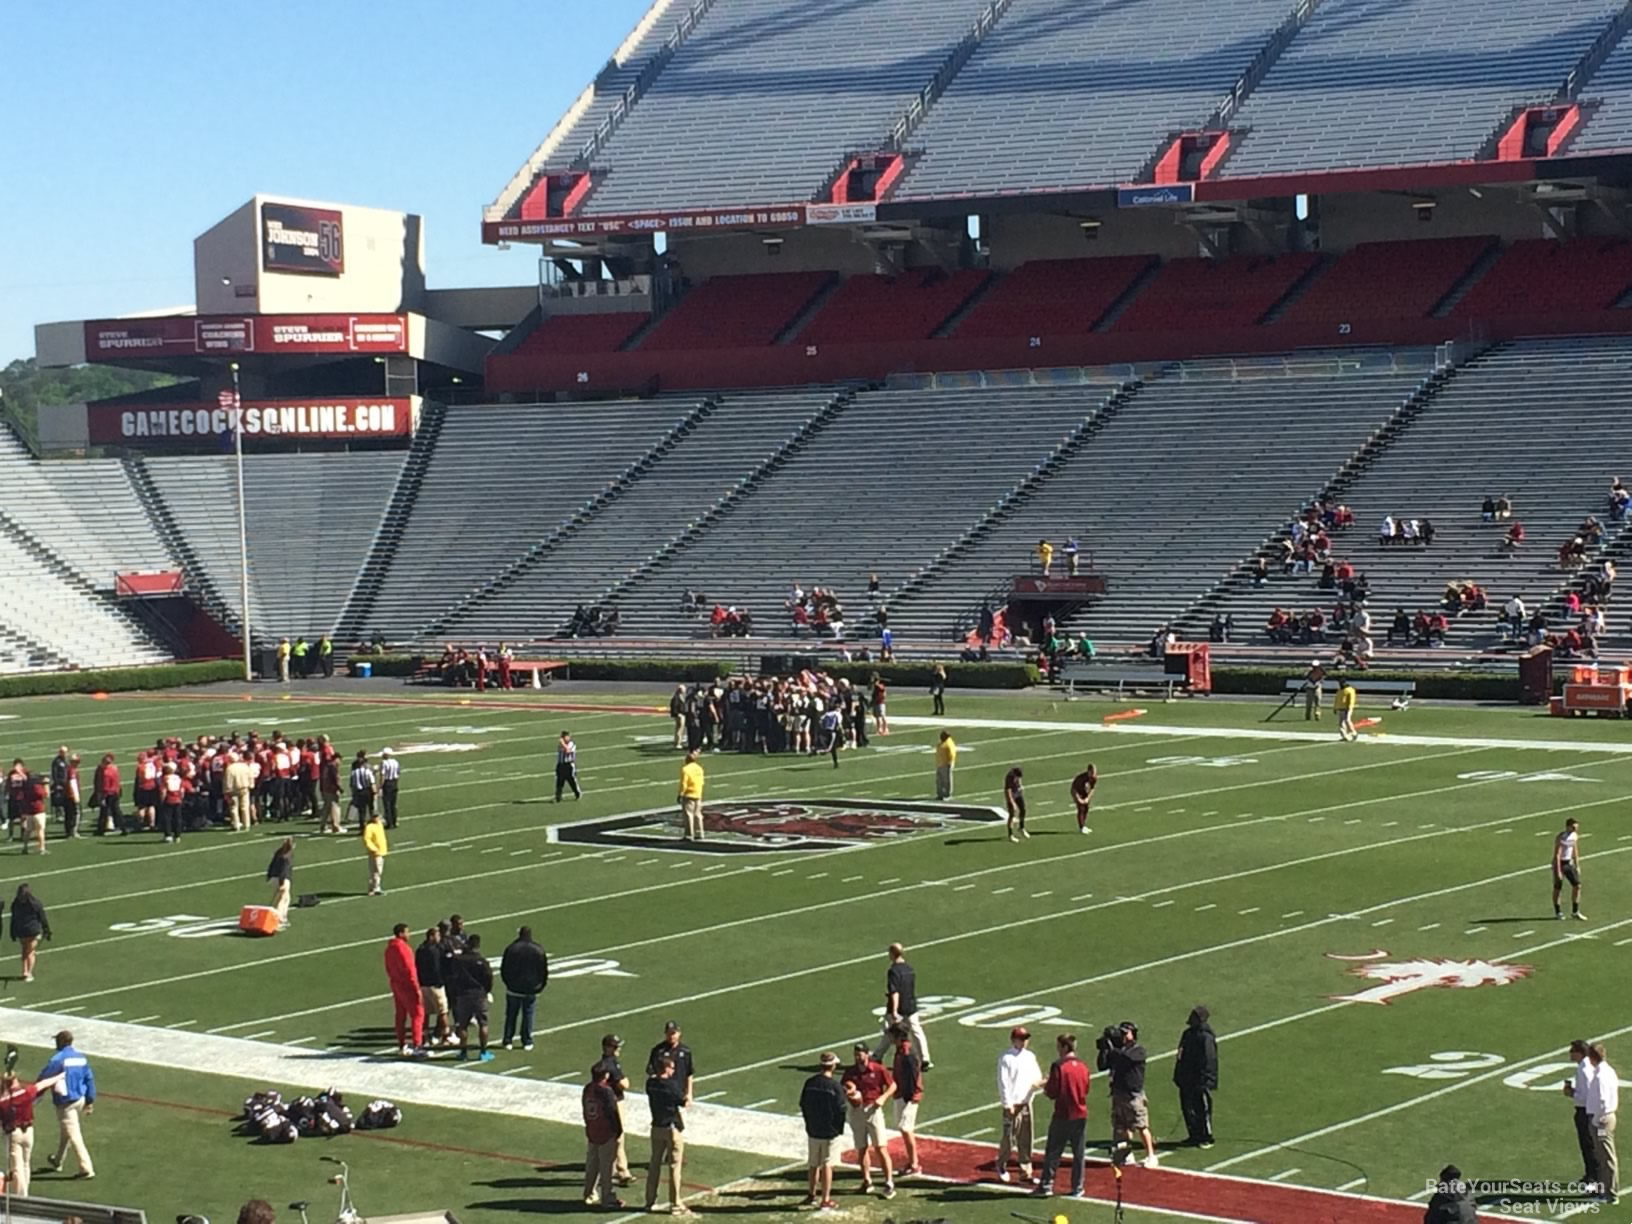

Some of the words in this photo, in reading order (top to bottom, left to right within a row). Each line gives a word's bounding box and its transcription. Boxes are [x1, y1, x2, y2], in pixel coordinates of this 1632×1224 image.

[498, 226, 519, 236] NEED
[521, 222, 575, 235] ASSISTANCE?
[577, 221, 596, 231] TEXT
[627, 217, 667, 230] <SPACE>
[668, 216, 693, 227] ISSUE
[695, 215, 713, 226] AND
[714, 213, 755, 226] LOCATION
[756, 213, 768, 224] TO
[267, 228, 319, 248] JOHNSON
[319, 220, 343, 263] 56
[1338, 323, 1351, 334] 23
[98, 338, 163, 349] SPURRIER
[273, 333, 344, 343] SPURRIER
[1029, 336, 1041, 347] 24
[121, 404, 395, 437] GAMECOCKSONLINE.COM
